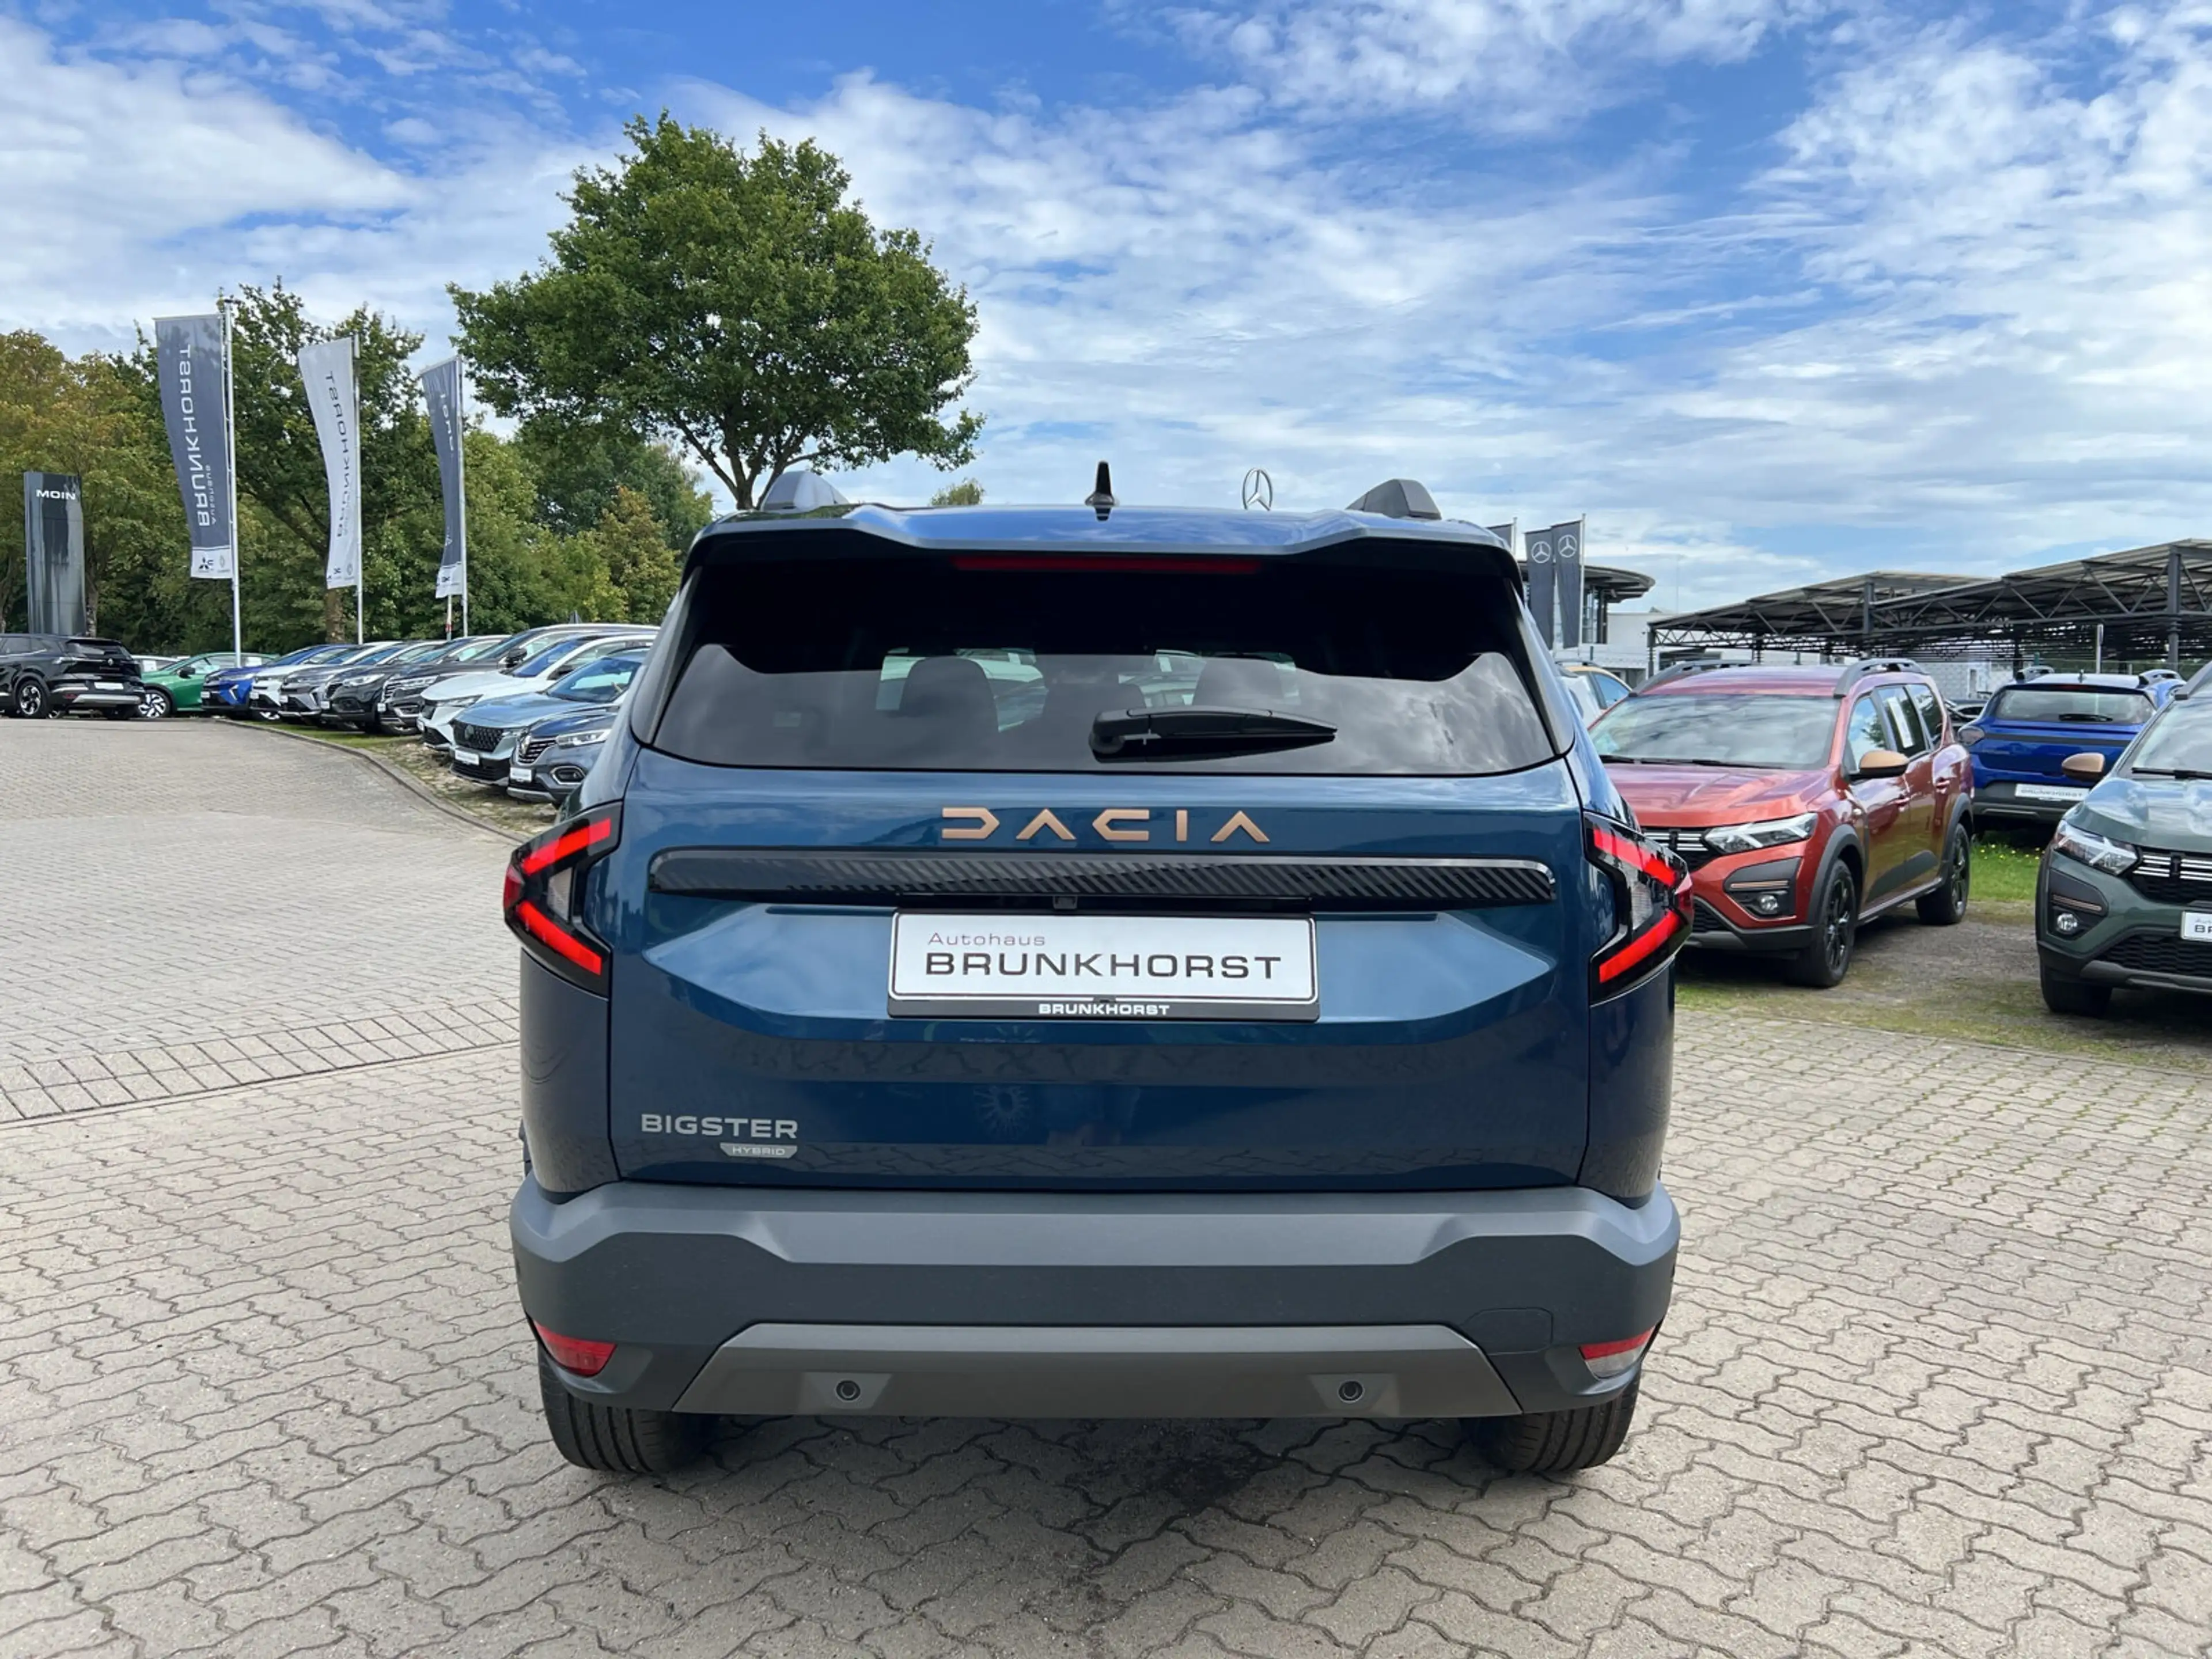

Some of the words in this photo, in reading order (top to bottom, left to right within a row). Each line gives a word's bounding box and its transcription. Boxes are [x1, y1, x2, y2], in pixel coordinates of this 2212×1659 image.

[36, 489, 76, 501] MOIN
[941, 807, 1271, 843] DACIA
[927, 932, 1046, 946] Autohaus
[926, 952, 1282, 979] BRUNKHORST
[1038, 1003, 1170, 1016] BRUNKHORST
[641, 1113, 798, 1139] BIGSTER
[732, 1145, 786, 1156] HYBRID
